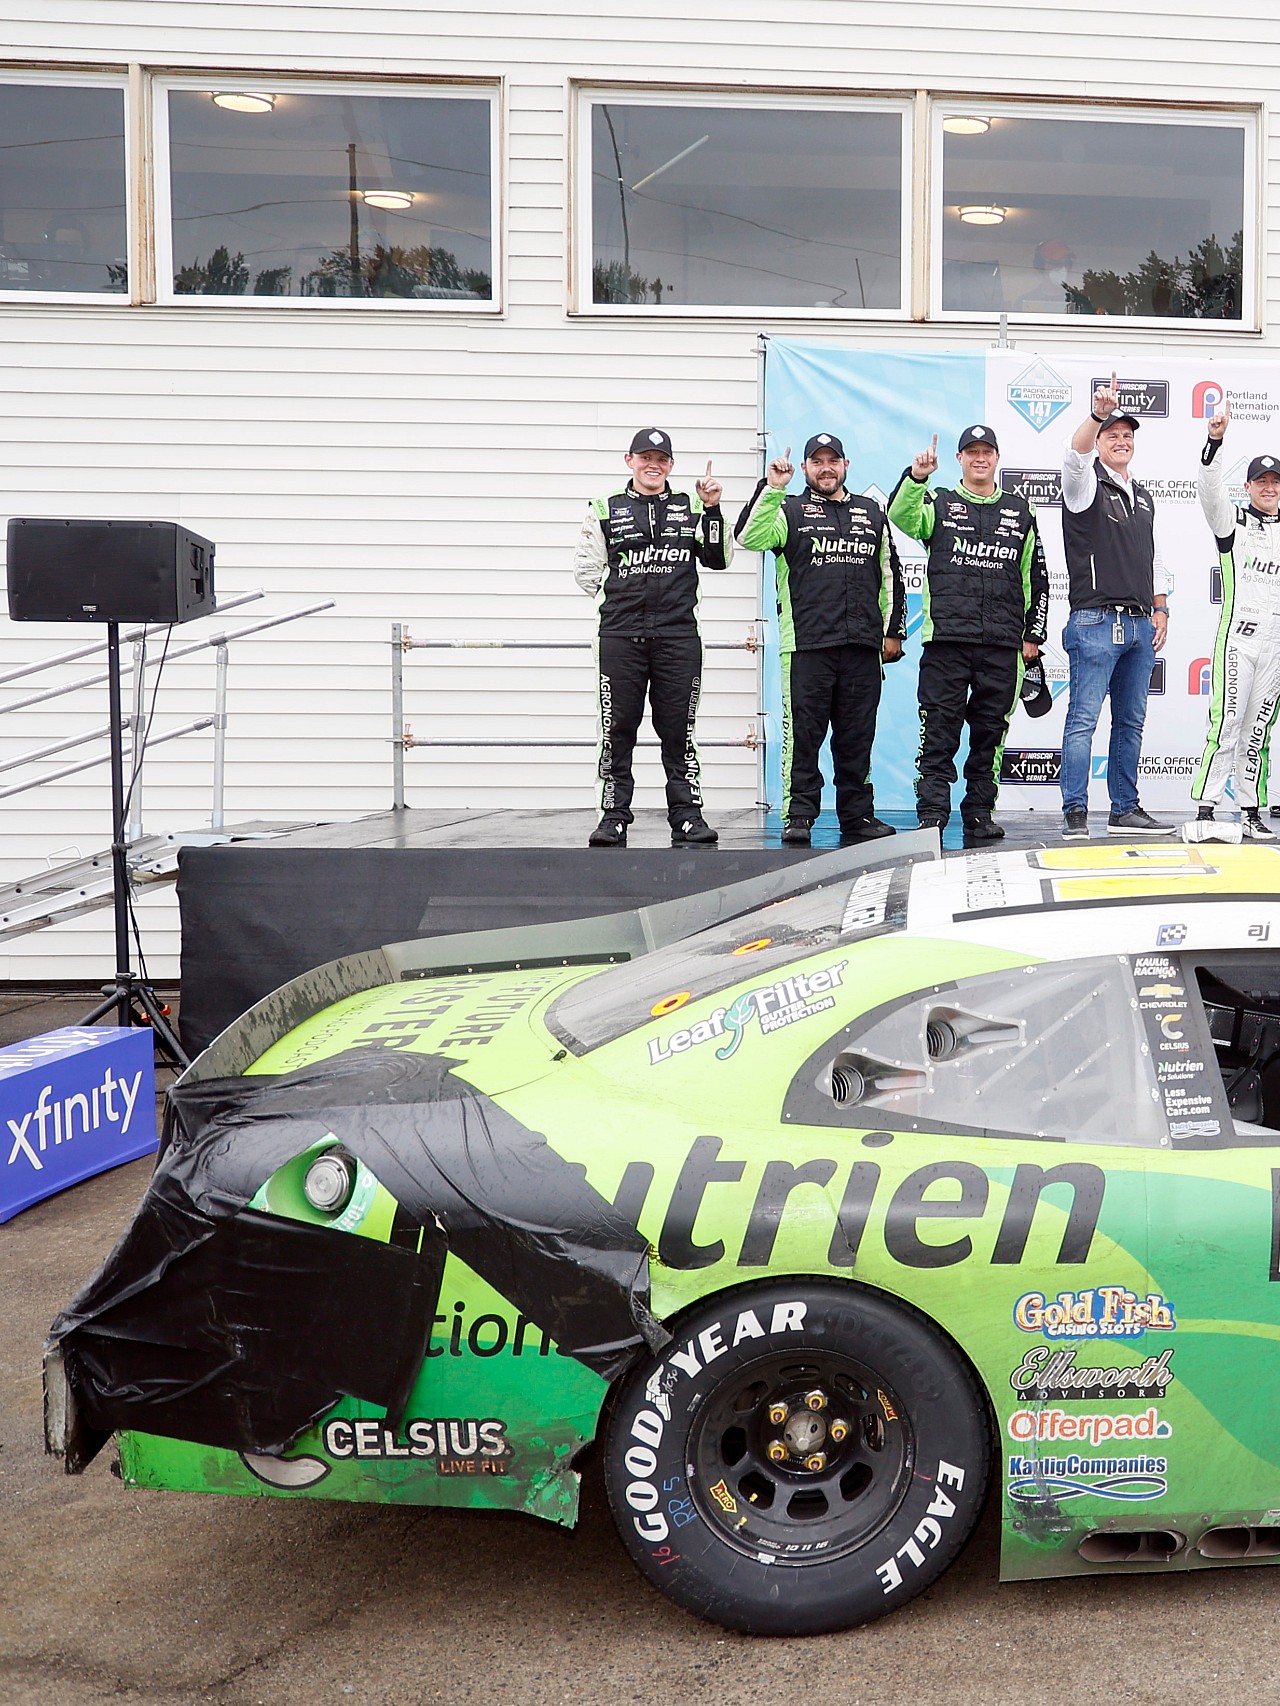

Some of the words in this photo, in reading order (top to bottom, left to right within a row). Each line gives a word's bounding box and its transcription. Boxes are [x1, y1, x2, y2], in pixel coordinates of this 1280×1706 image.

[1120, 383, 1148, 391] NASCAR
[1226, 390, 1268, 400] Portland
[1116, 391, 1157, 409] finity
[1027, 401, 1052, 417] 147
[1027, 473, 1057, 481] NASCAR
[1139, 480, 1165, 489] CIFIC
[1168, 480, 1198, 489] OFFIC
[1012, 481, 1063, 500] xfinity
[1149, 489, 1197, 499] OMATION
[811, 537, 875, 556] Nutrien
[953, 536, 1018, 561] Nutrien
[618, 544, 690, 567] Nutrien
[811, 555, 823, 566] Ag
[825, 554, 865, 565] Solutions
[950, 555, 963, 567] Ag
[964, 558, 1004, 570] Solutions
[618, 568, 628, 579] Ag
[629, 564, 673, 575] Solutions
[1241, 572, 1252, 583] Ag
[1031, 592, 1048, 638] Nutrien
[1236, 620, 1258, 637] 16
[1227, 645, 1239, 717] AGRONOMIC
[600, 673, 613, 749] AGRONOMIC
[1245, 726, 1263, 782] LEADING
[1257, 698, 1274, 725] THE
[1027, 752, 1054, 760] NASCAR
[1164, 757, 1201, 766] OFFICE
[1010, 759, 1062, 778] xfinity
[1137, 766, 1193, 774] TOMATION
[684, 752, 703, 805] LEADING
[1247, 923, 1271, 942] aj
[1135, 958, 1169, 967] KAULIG
[1134, 966, 1169, 977] RACING
[647, 1005, 729, 1065] Leaf
[753, 960, 849, 1015] Filter
[761, 998, 806, 1026] GUTTER
[1139, 1001, 1188, 1009] CHEVROLET
[350, 977, 496, 1051] FASTER
[761, 996, 835, 1034] PROTECTION
[279, 1027, 341, 1070] PODCAST
[1160, 1042, 1190, 1050] CELSIUS
[1158, 1060, 1203, 1073] Nutrien
[1158, 1073, 1166, 1082] Ag
[1167, 1073, 1194, 1081] Solutions
[1164, 1088, 1186, 1097] Less
[1165, 1095, 1212, 1108] Expensive
[6, 1067, 143, 1170] xfinity
[1166, 1105, 1211, 1117] Cars.com
[1015, 1290, 1094, 1331] Gold
[1098, 1287, 1174, 1329] Fish
[1048, 1323, 1098, 1336] CASINO
[1100, 1322, 1141, 1335] SLOTS
[1011, 1346, 1174, 1391] Ellsworth
[1019, 1389, 1165, 1400] ADVISORS
[1010, 1411, 1154, 1443] Offerpad
[326, 1421, 510, 1456] CELSIUS
[440, 1460, 476, 1473] LIVE
[480, 1460, 506, 1473] FIT
[1009, 1456, 1167, 1476] KauligCompanies
[714, 1486, 735, 1511] AERO
[875, 1459, 965, 1594] EAGLE
